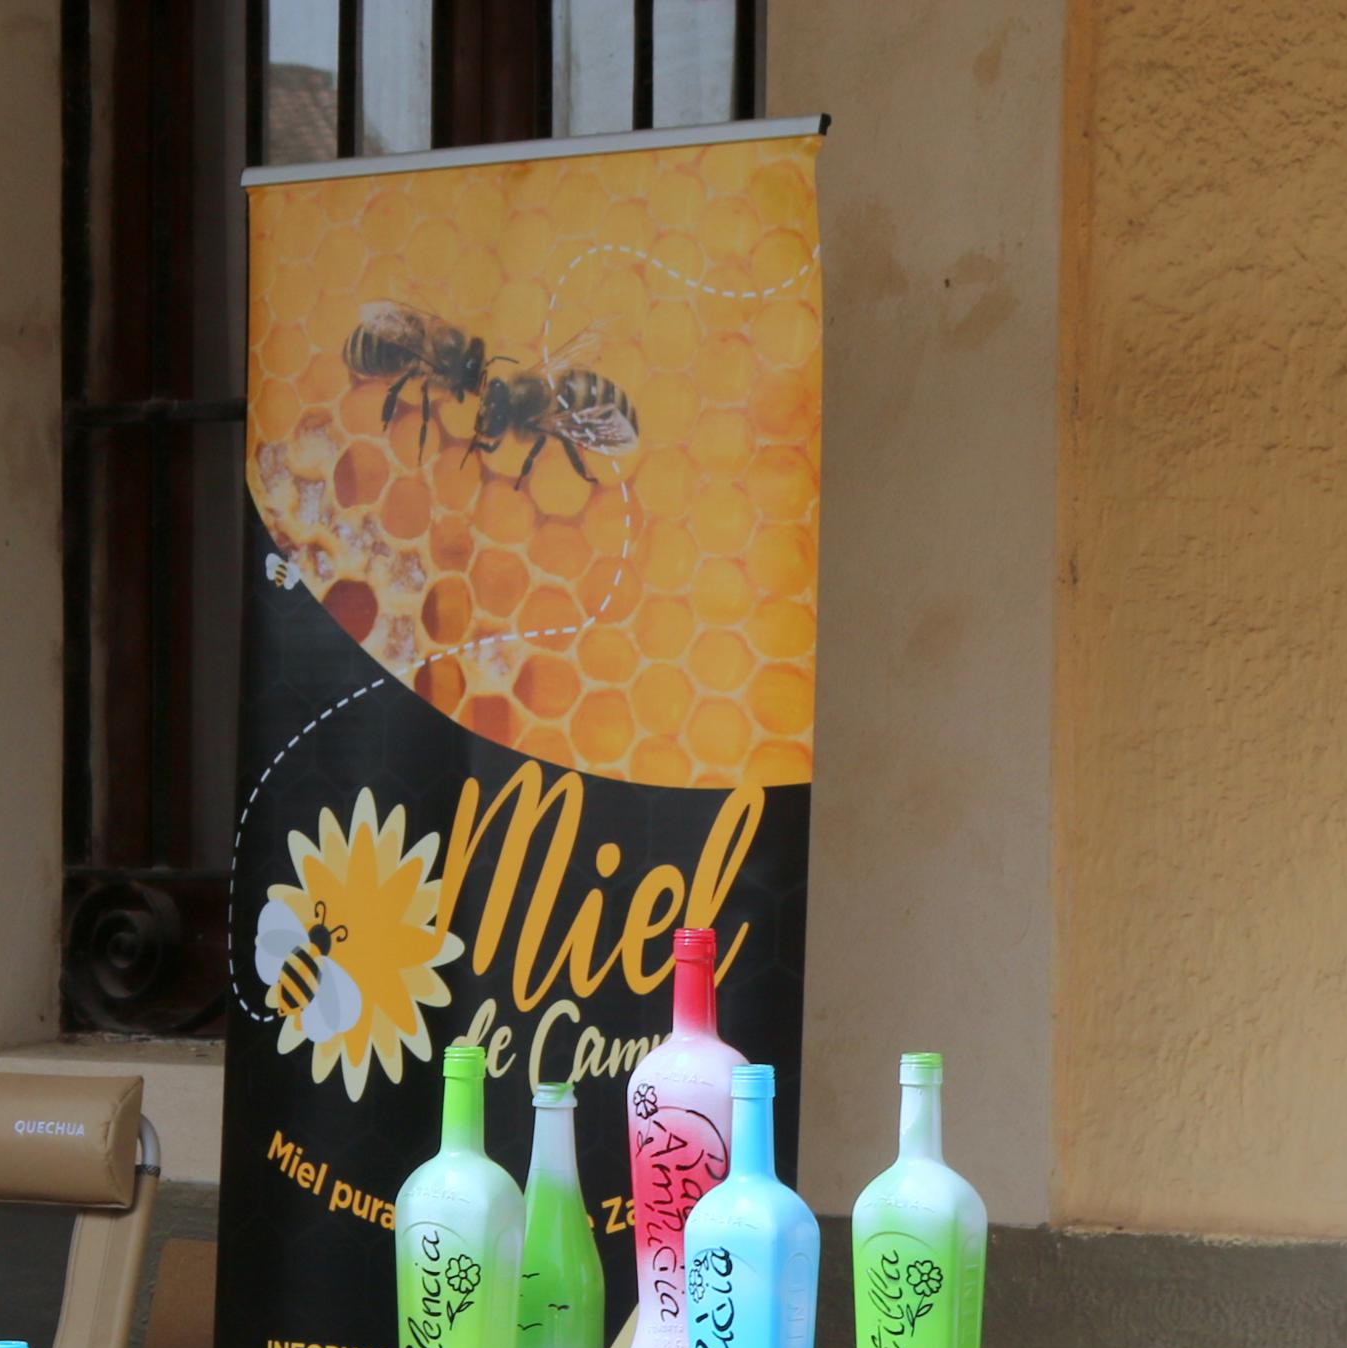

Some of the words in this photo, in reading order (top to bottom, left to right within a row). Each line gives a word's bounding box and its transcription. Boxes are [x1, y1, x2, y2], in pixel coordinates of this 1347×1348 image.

[430, 760, 765, 1013] Miel
[14, 1119, 85, 1137] QUECHUA
[267, 1130, 329, 1195] Miel
